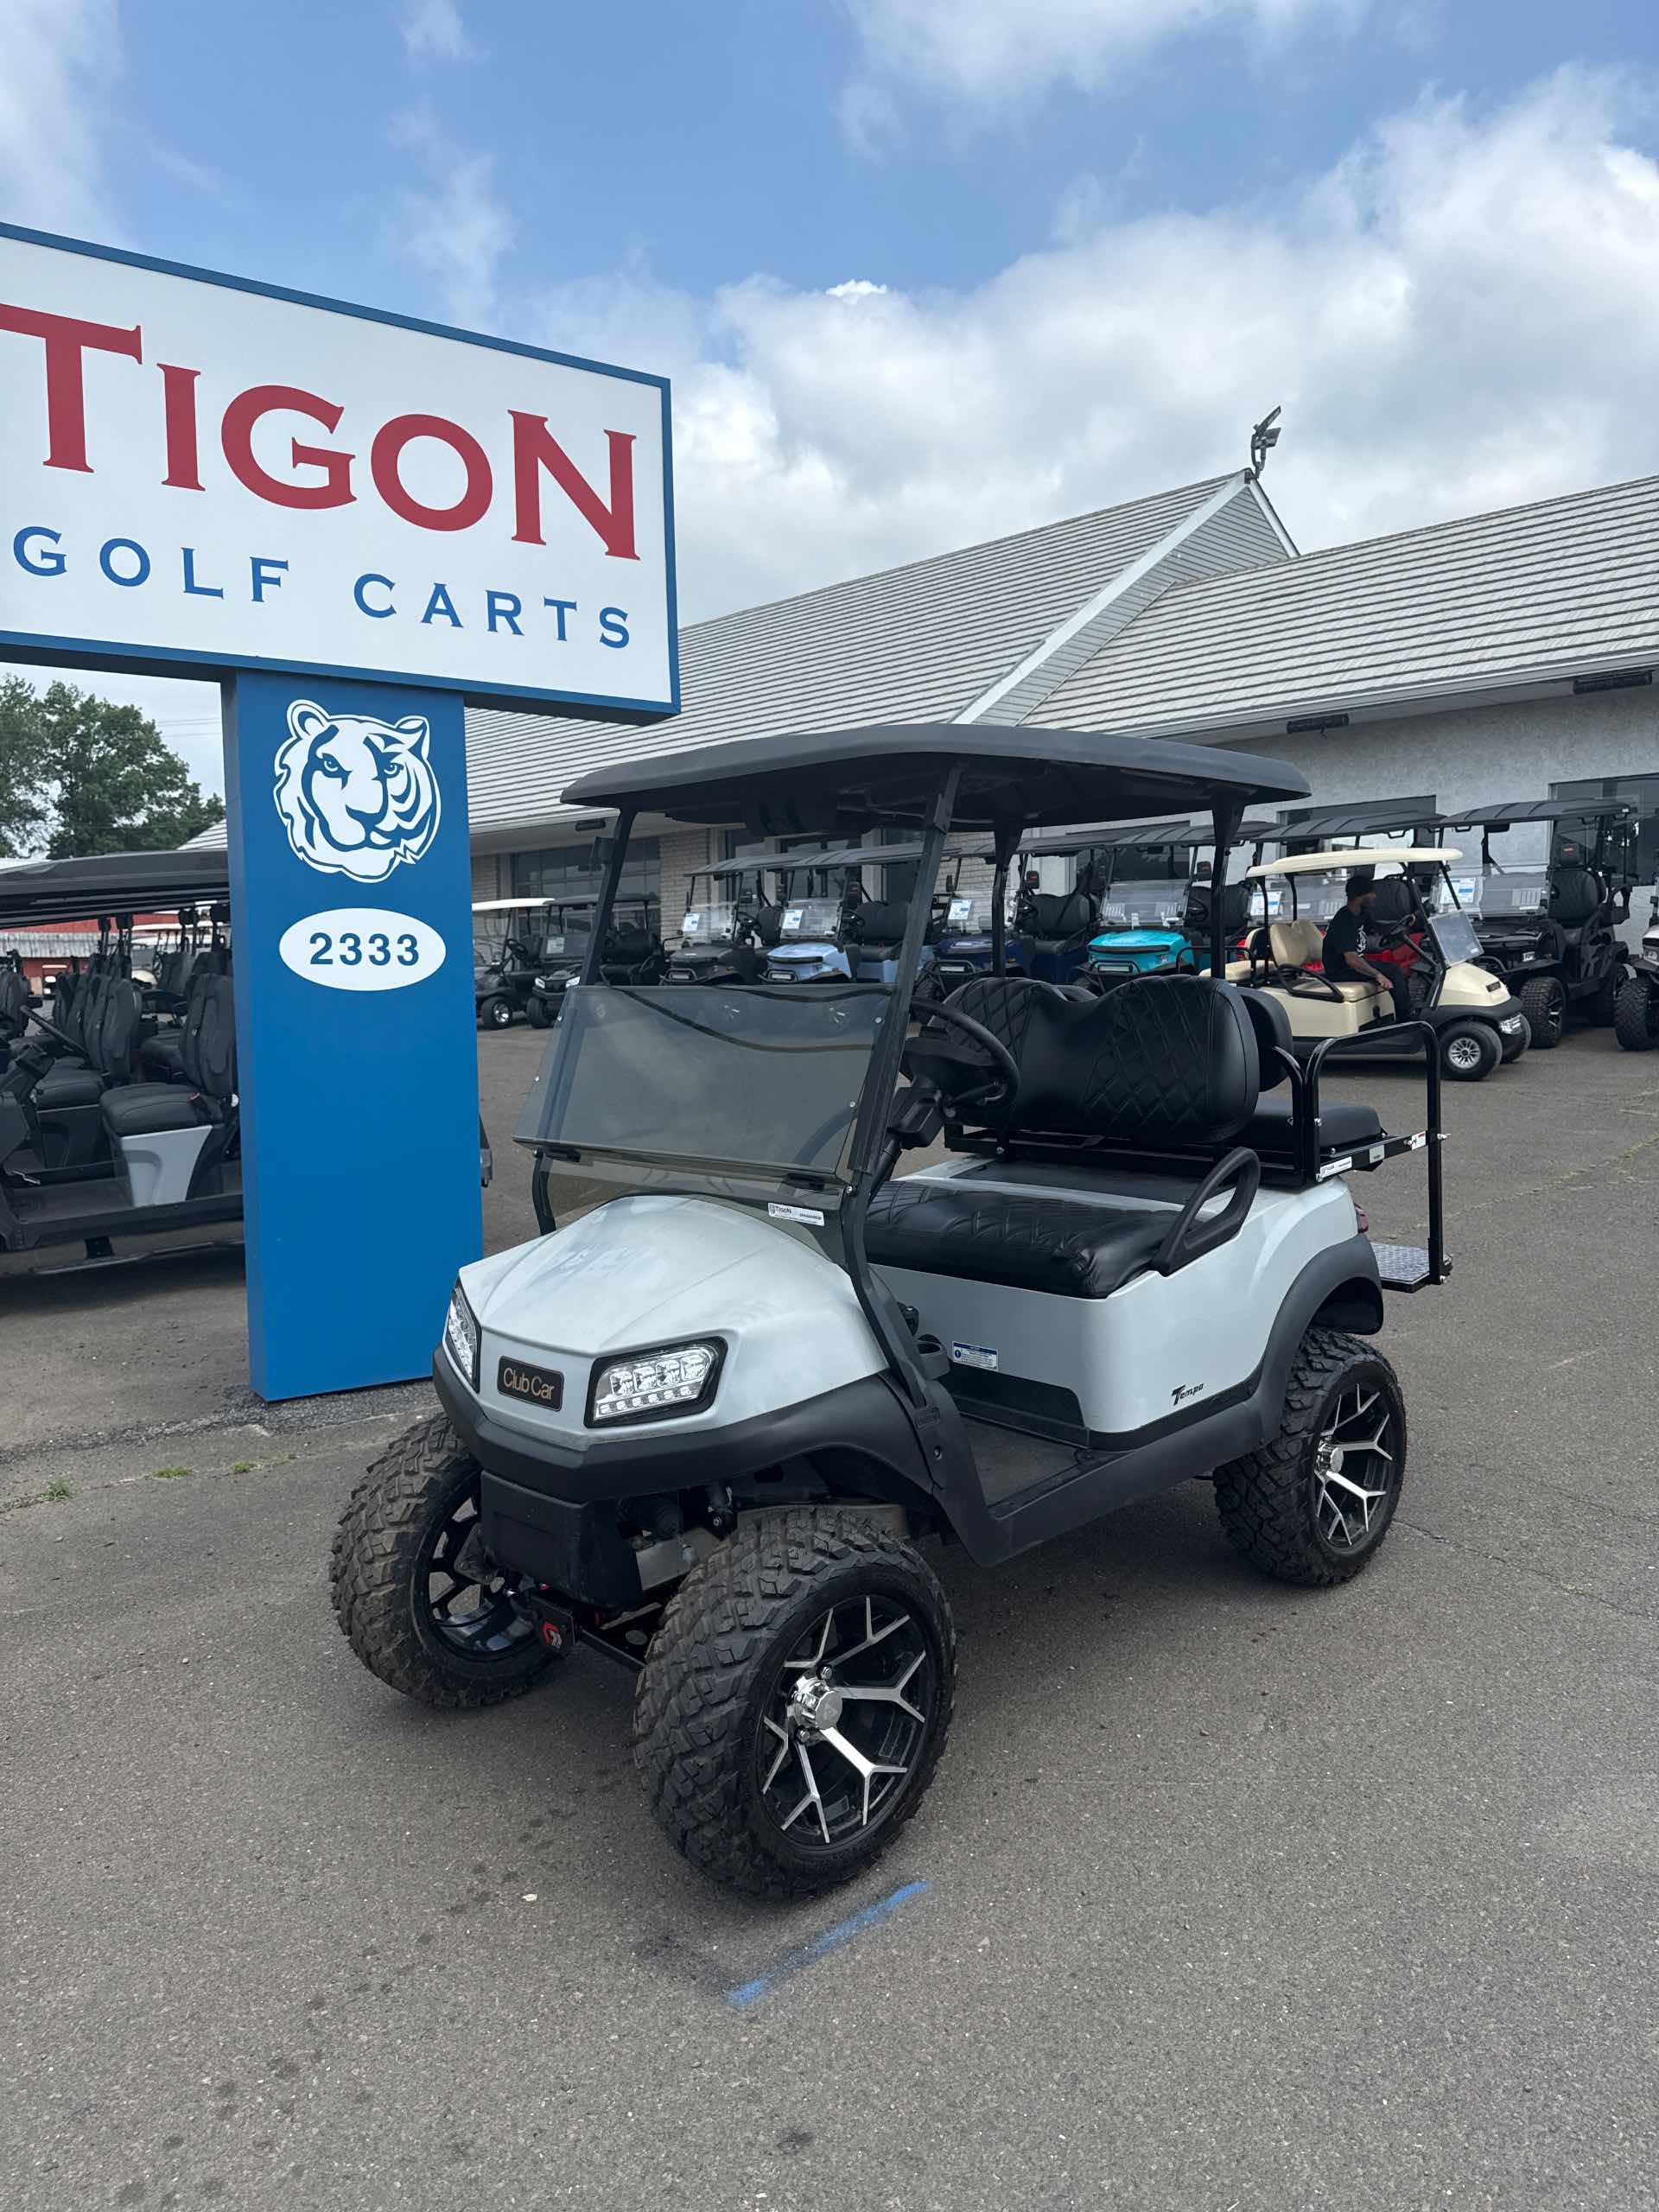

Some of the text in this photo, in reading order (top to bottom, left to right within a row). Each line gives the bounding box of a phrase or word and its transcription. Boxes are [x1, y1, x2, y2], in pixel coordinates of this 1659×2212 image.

[0, 303, 640, 562] TIGON
[13, 525, 631, 650] GOLF CARTS
[309, 932, 419, 967] 2333
[504, 1368, 554, 1400] Club Car
[1171, 1382, 1204, 1406] Tempo
